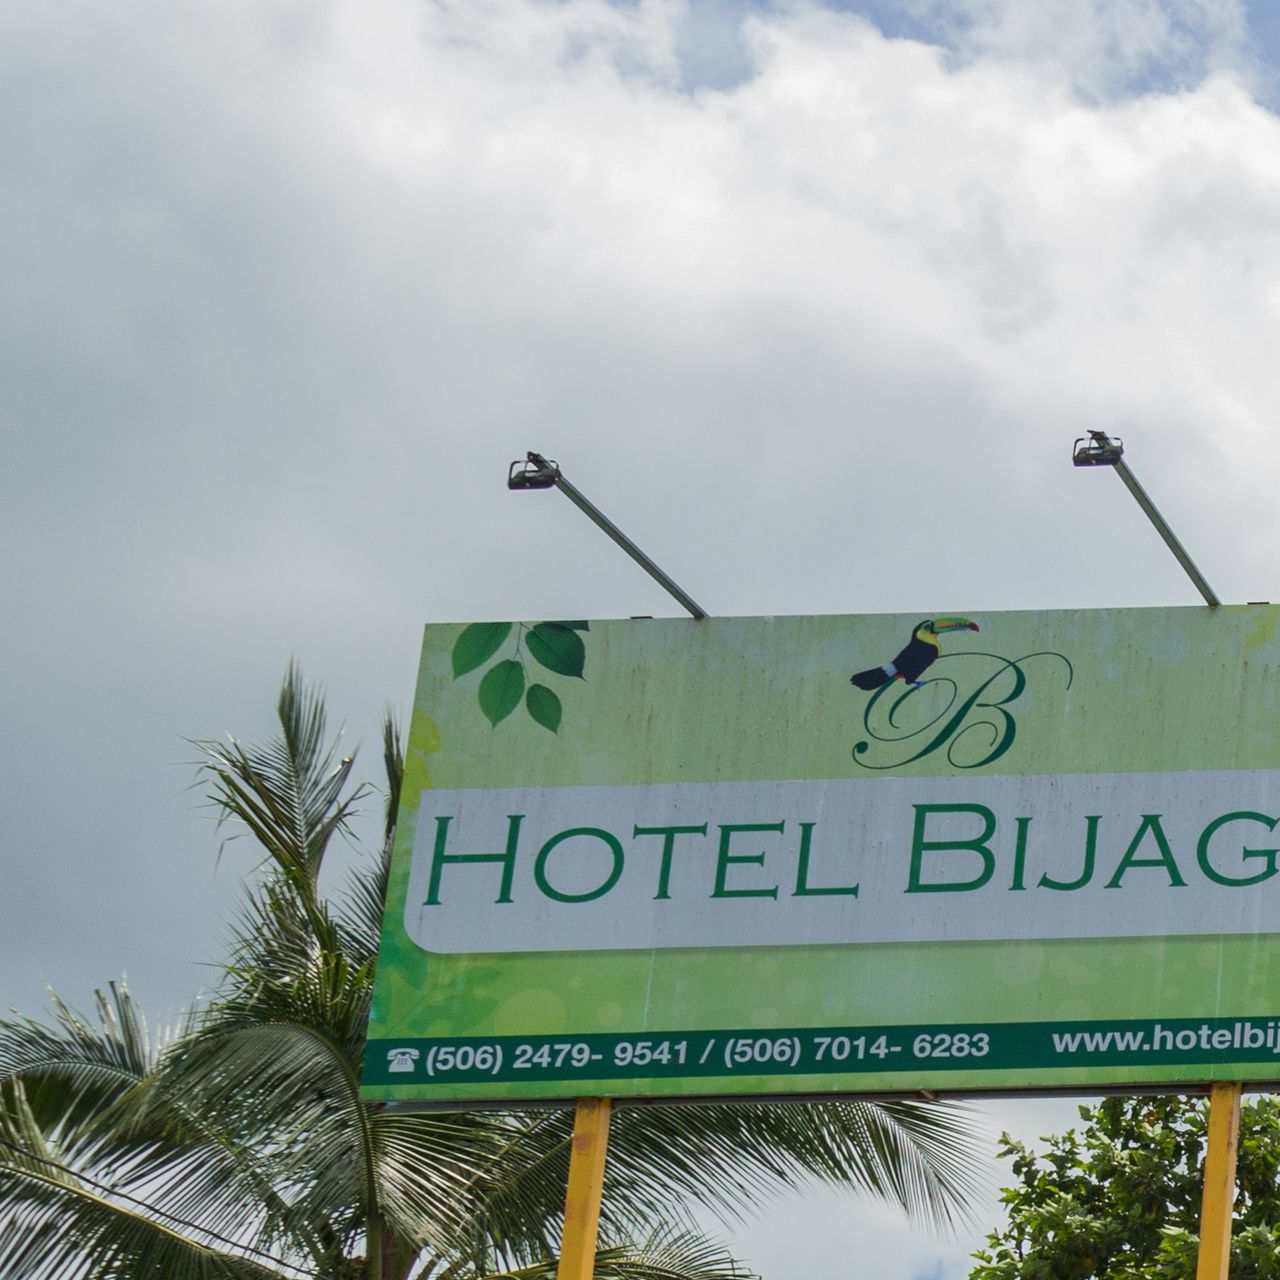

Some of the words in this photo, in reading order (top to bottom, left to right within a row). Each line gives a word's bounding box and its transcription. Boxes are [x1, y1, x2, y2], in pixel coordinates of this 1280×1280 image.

[425, 1045, 503, 1076] (506)
[513, 1043, 602, 1068] 2479-
[614, 1040, 687, 1066] 9541
[699, 1039, 715, 1063] /
[724, 1037, 801, 1067] (506)
[813, 1035, 901, 1061] 7014-
[913, 1033, 990, 1058] 6283
